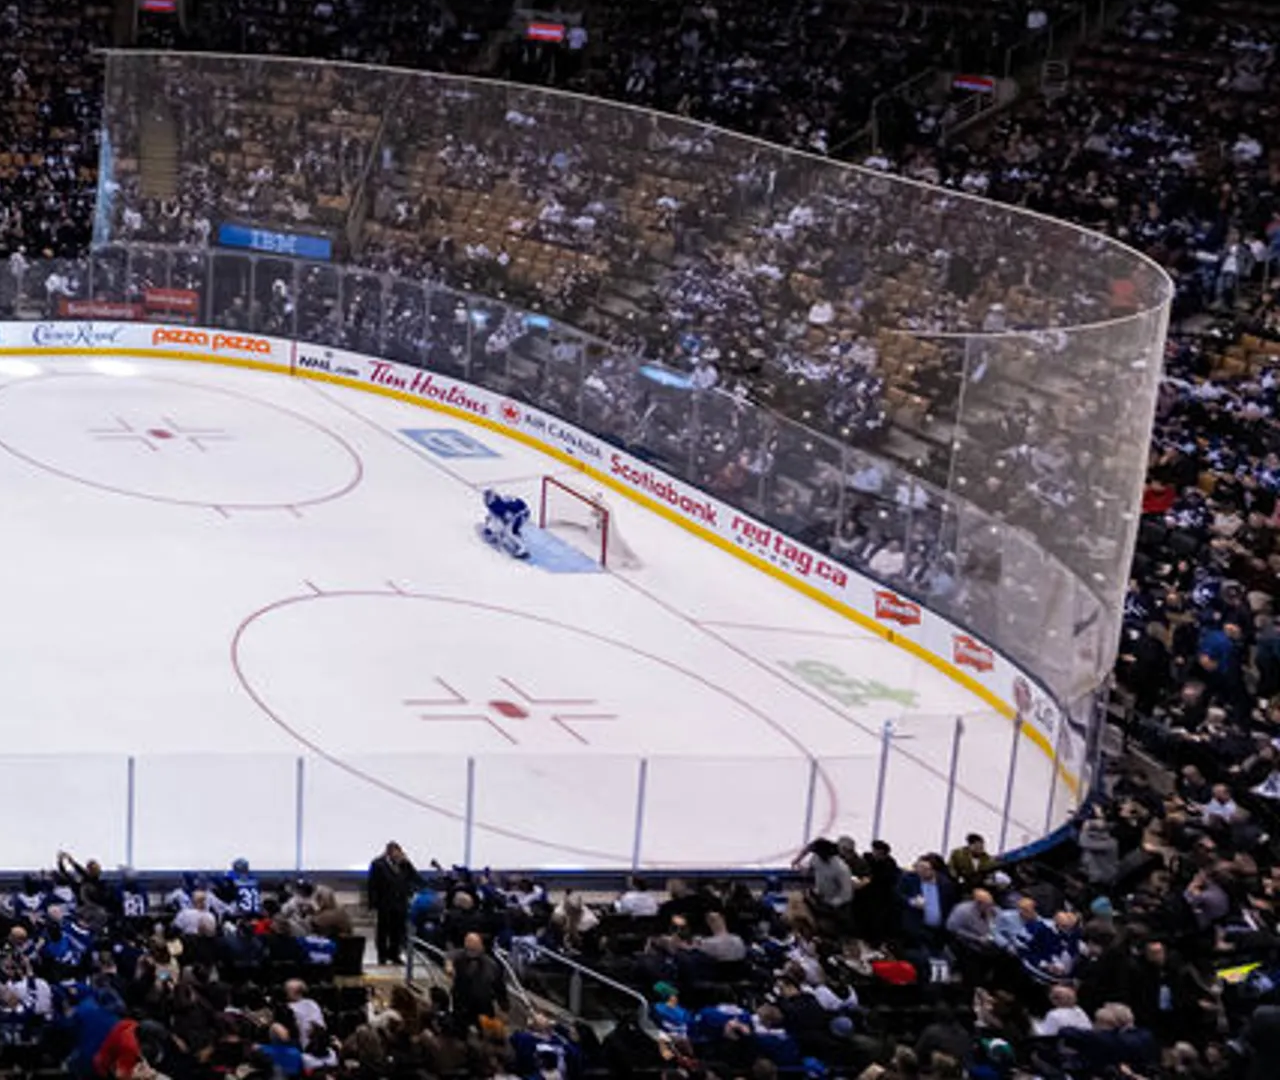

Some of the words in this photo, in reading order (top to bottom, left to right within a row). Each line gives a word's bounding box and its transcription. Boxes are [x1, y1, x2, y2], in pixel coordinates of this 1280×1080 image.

[252, 226, 297, 254] IBM
[152, 327, 208, 347] pizza
[212, 332, 271, 355] pizza
[368, 359, 406, 389] Tim
[409, 368, 490, 417] Hortons
[548, 423, 604, 461] CANADA
[610, 453, 718, 527] Scotiabank
